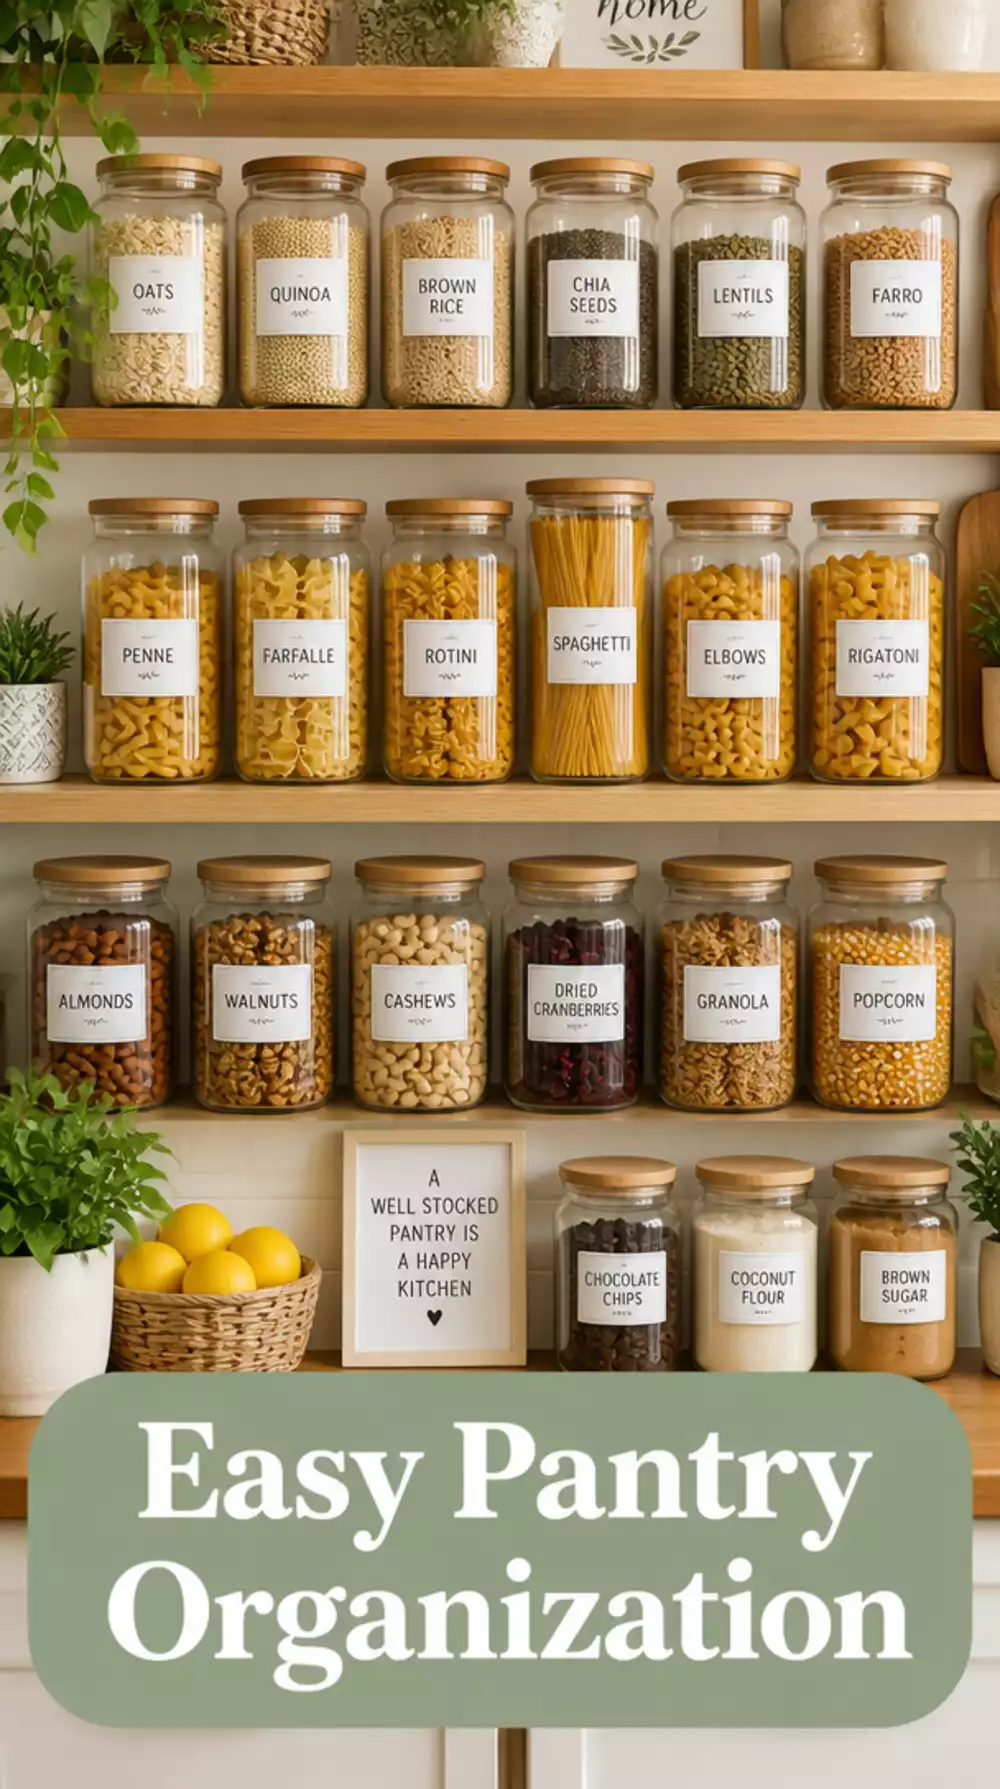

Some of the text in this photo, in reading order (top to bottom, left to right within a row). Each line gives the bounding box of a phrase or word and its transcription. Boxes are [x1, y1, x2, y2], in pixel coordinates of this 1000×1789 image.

[132, 283, 174, 300] OATS
[418, 278, 476, 295] BROWN
[573, 276, 611, 293] CHIA
[270, 286, 331, 305] QUINOA
[713, 287, 774, 304] LENTILS
[872, 287, 922, 304] FARRO
[430, 298, 463, 314] RICE
[569, 297, 617, 314] SEEDS
[552, 635, 631, 652] SPAGHETTI
[122, 647, 173, 664] PENNE
[262, 647, 333, 664] FARFALLE
[425, 648, 477, 664] ROTINI
[703, 648, 766, 665] ELBOWS
[848, 647, 919, 664] RIGATONI
[555, 982, 598, 999] DRIED
[58, 993, 133, 1010] ALMONDS
[224, 993, 298, 1009] WALNUTS
[384, 992, 456, 1009] CASHEWS
[533, 1000, 619, 1017] CRANBERRIES
[696, 993, 769, 1010] GRANOLA
[853, 992, 925, 1009] POPCORN
[428, 1169, 440, 1187] A
[370, 1196, 499, 1215] WELL STOCKED
[390, 1224, 480, 1242] PANTRY IS
[397, 1252, 472, 1270] A HAPPY
[584, 1270, 660, 1288] CHOCOLATE
[730, 1270, 795, 1287] COCONUT
[881, 1270, 930, 1285] BROWN
[398, 1279, 472, 1298] KITCHEN
[881, 1288, 927, 1304] SUGAR
[602, 1291, 643, 1307] CHIPS
[741, 1290, 785, 1305] FLOUR
